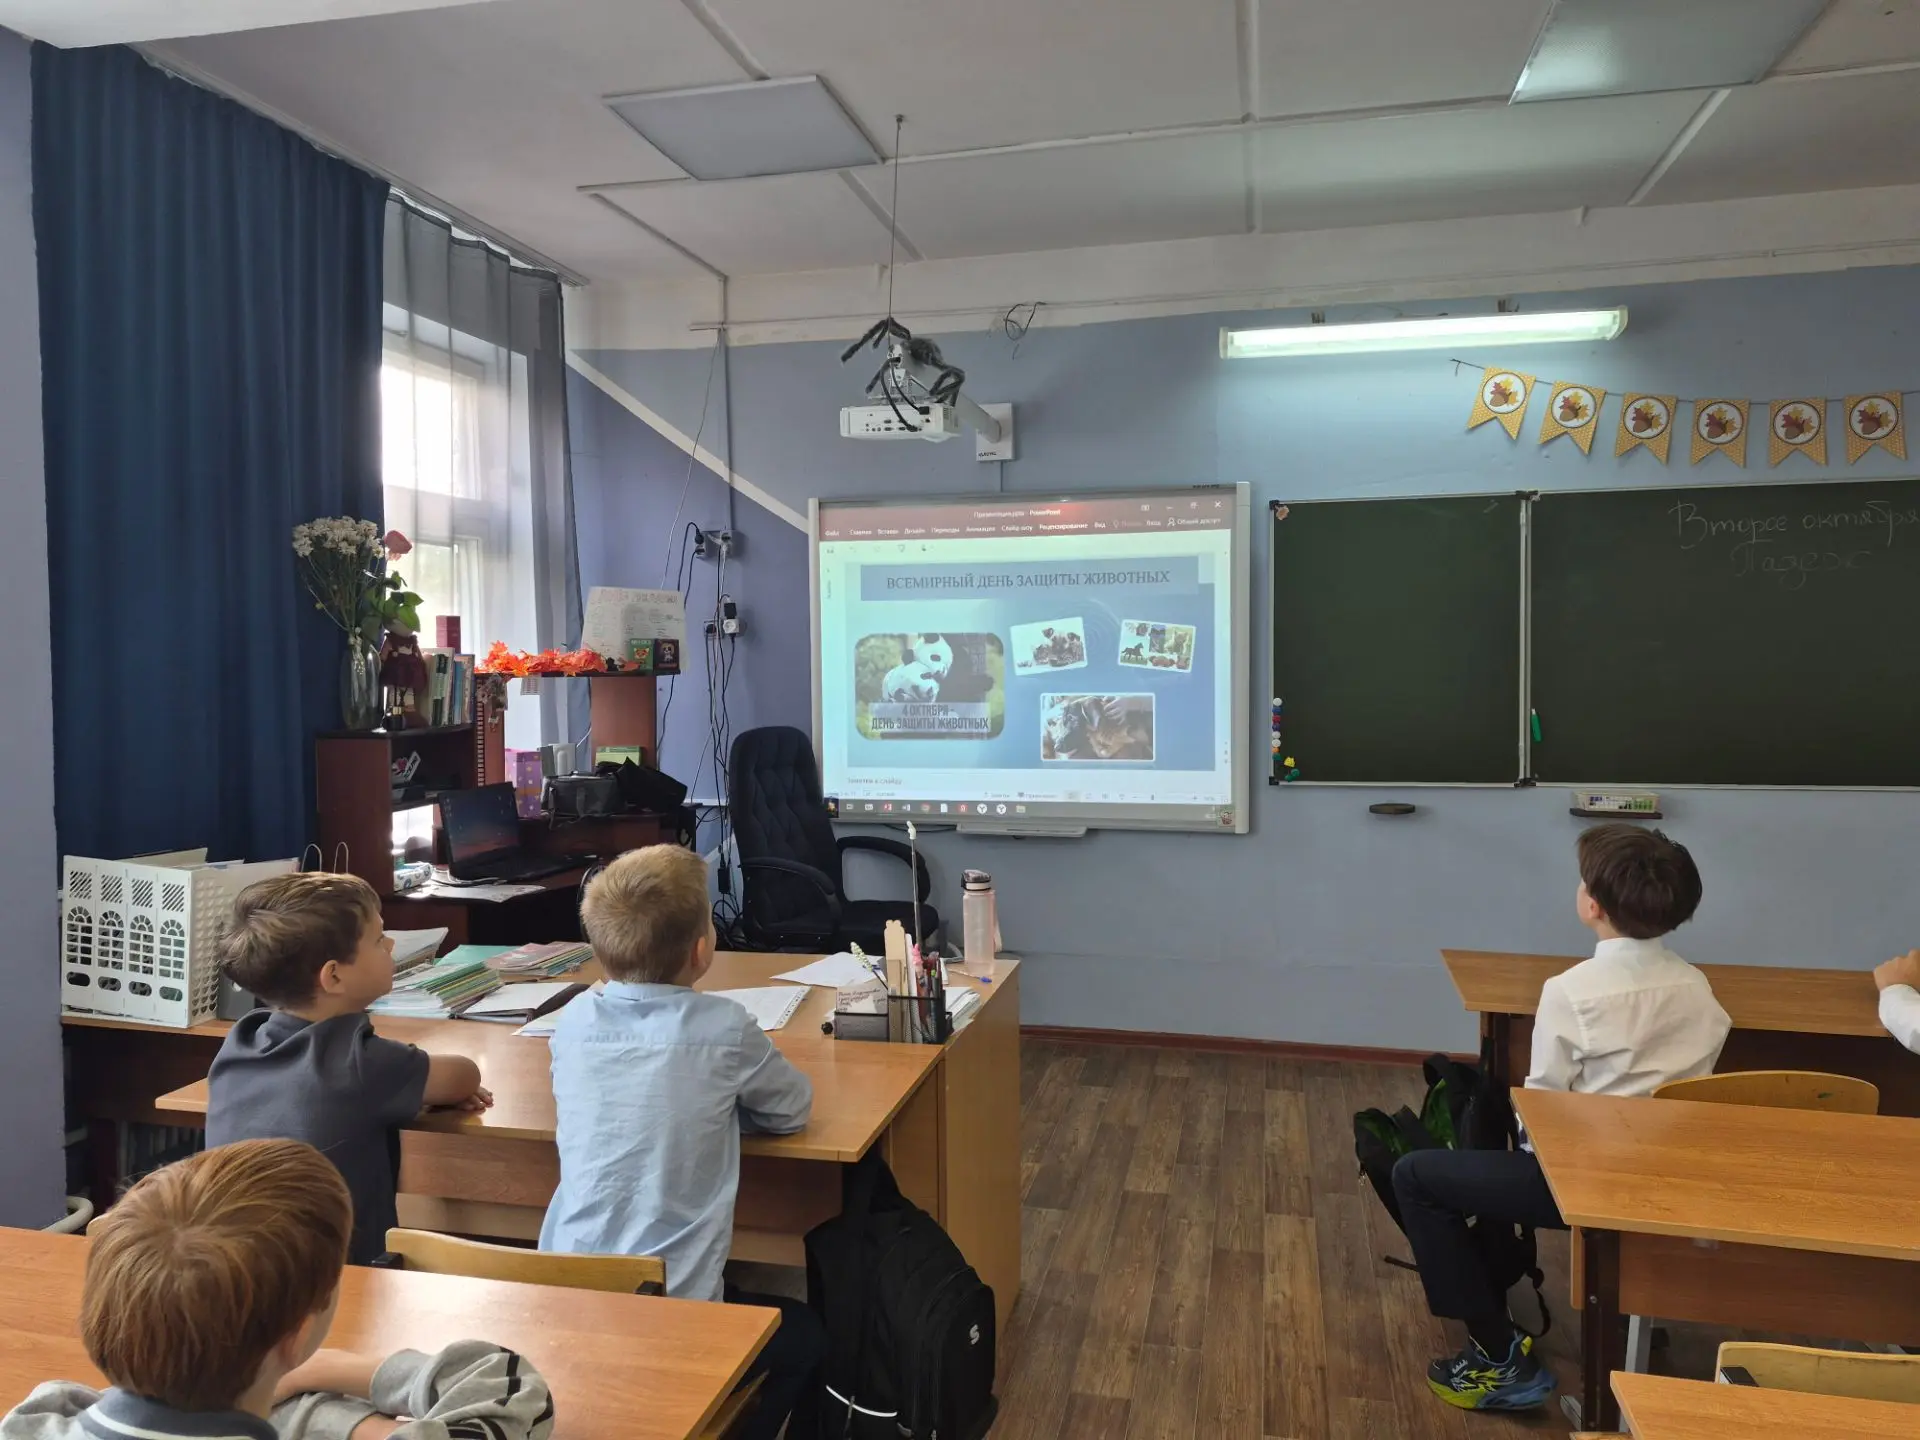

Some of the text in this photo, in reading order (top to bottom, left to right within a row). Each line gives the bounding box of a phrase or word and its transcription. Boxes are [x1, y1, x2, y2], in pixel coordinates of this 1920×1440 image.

[1803, 500, 1920, 548] октября
[887, 571, 1171, 591] ВСЕМИРНЫЙ ДЕНЬ ЗАЩИТЫ ЖИВОТНЫХ
[909, 704, 949, 716] ОКТЯБРЯ
[872, 717, 989, 730] ДЕНЬ ЗАЩИТЫ ЖИВОТНЫХ
